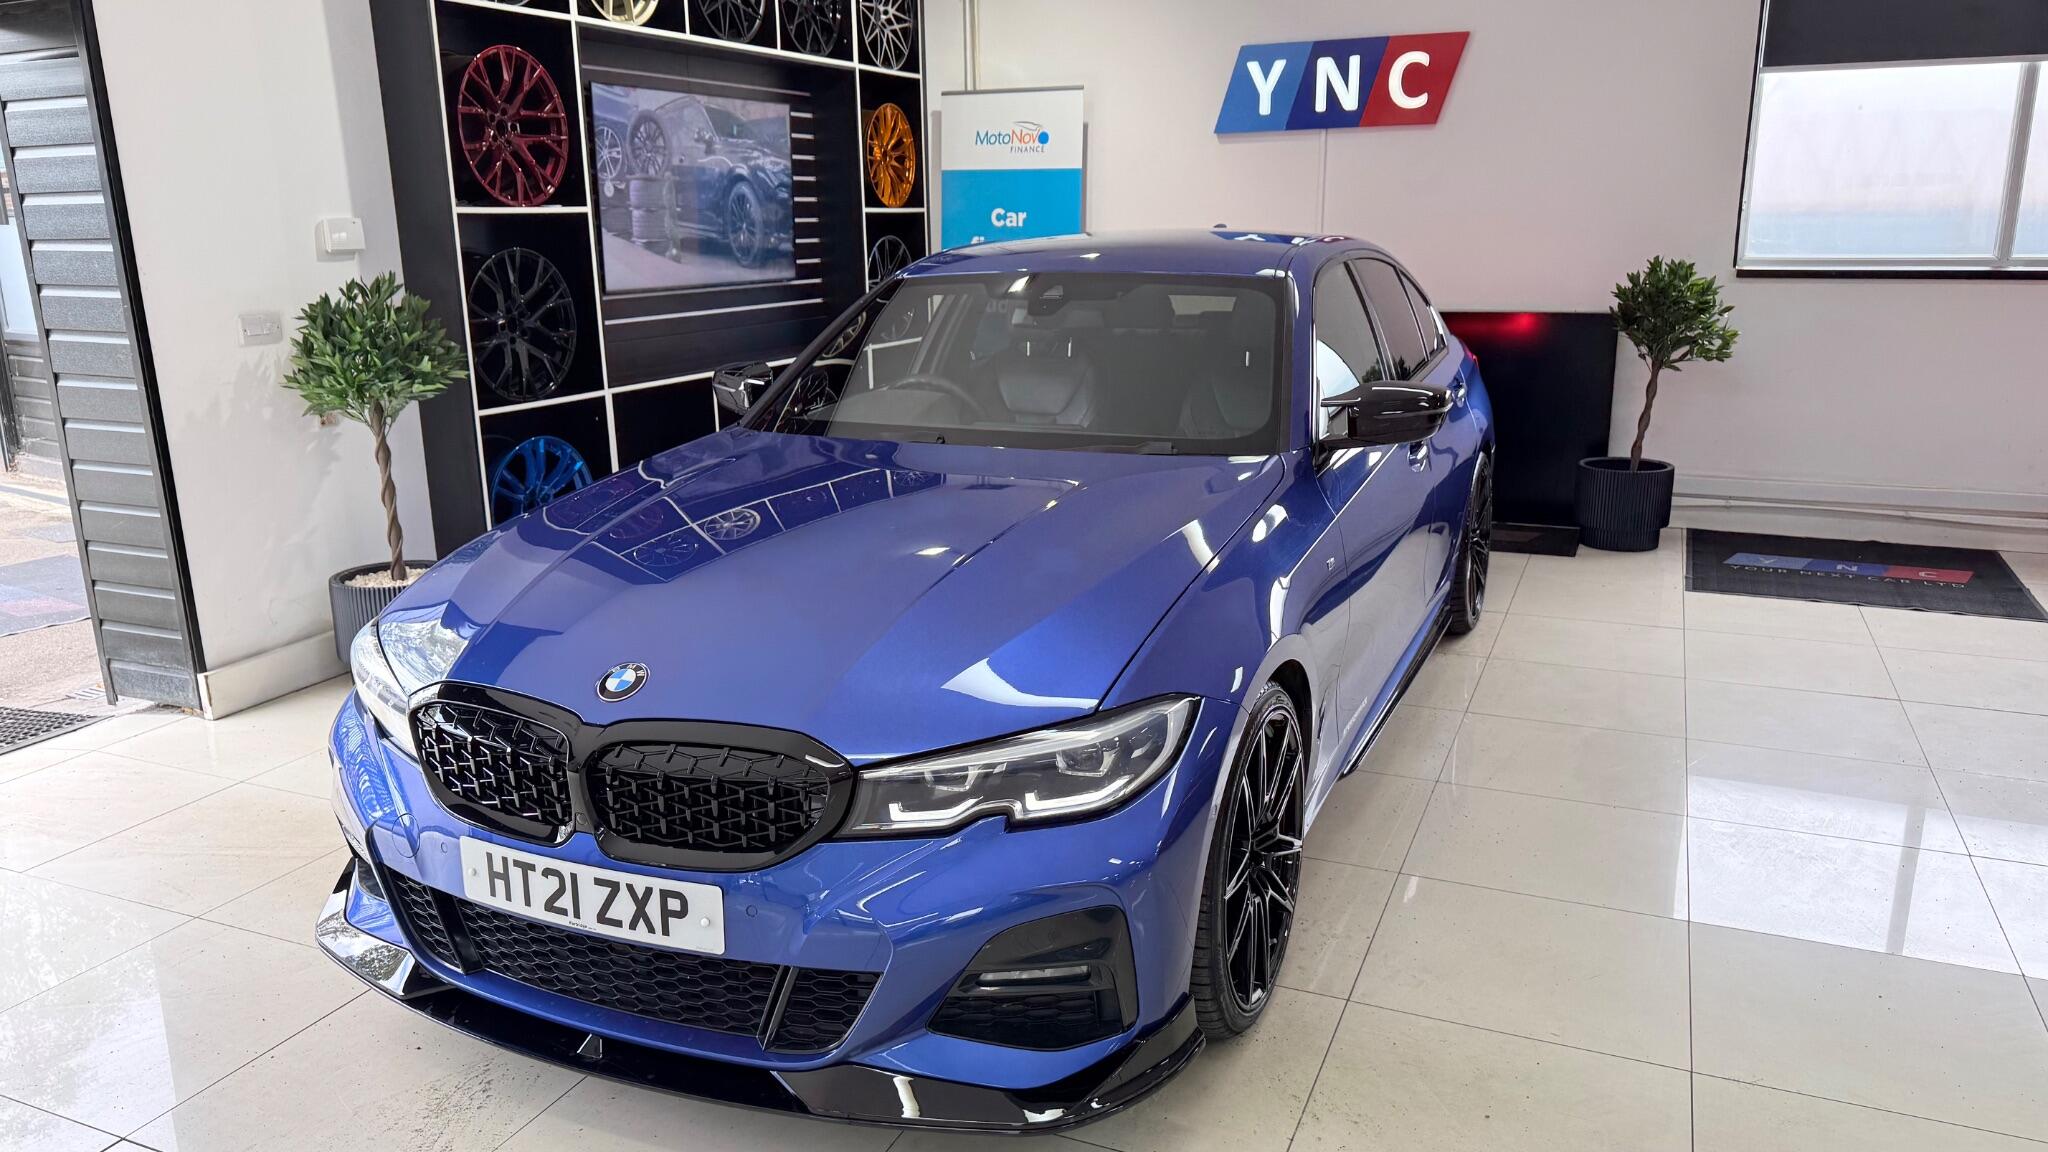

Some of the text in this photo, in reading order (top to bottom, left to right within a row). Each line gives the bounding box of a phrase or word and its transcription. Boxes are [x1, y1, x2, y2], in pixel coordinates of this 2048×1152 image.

[1246, 50, 1430, 116] YNC
[975, 127, 1050, 146] MotoNovo
[991, 208, 1027, 227] Car
[1730, 565, 1787, 573] YOUR
[1800, 570, 1855, 579] NEXT
[1868, 576, 1910, 584] CAR
[486, 851, 689, 937] HT21 ZXP
